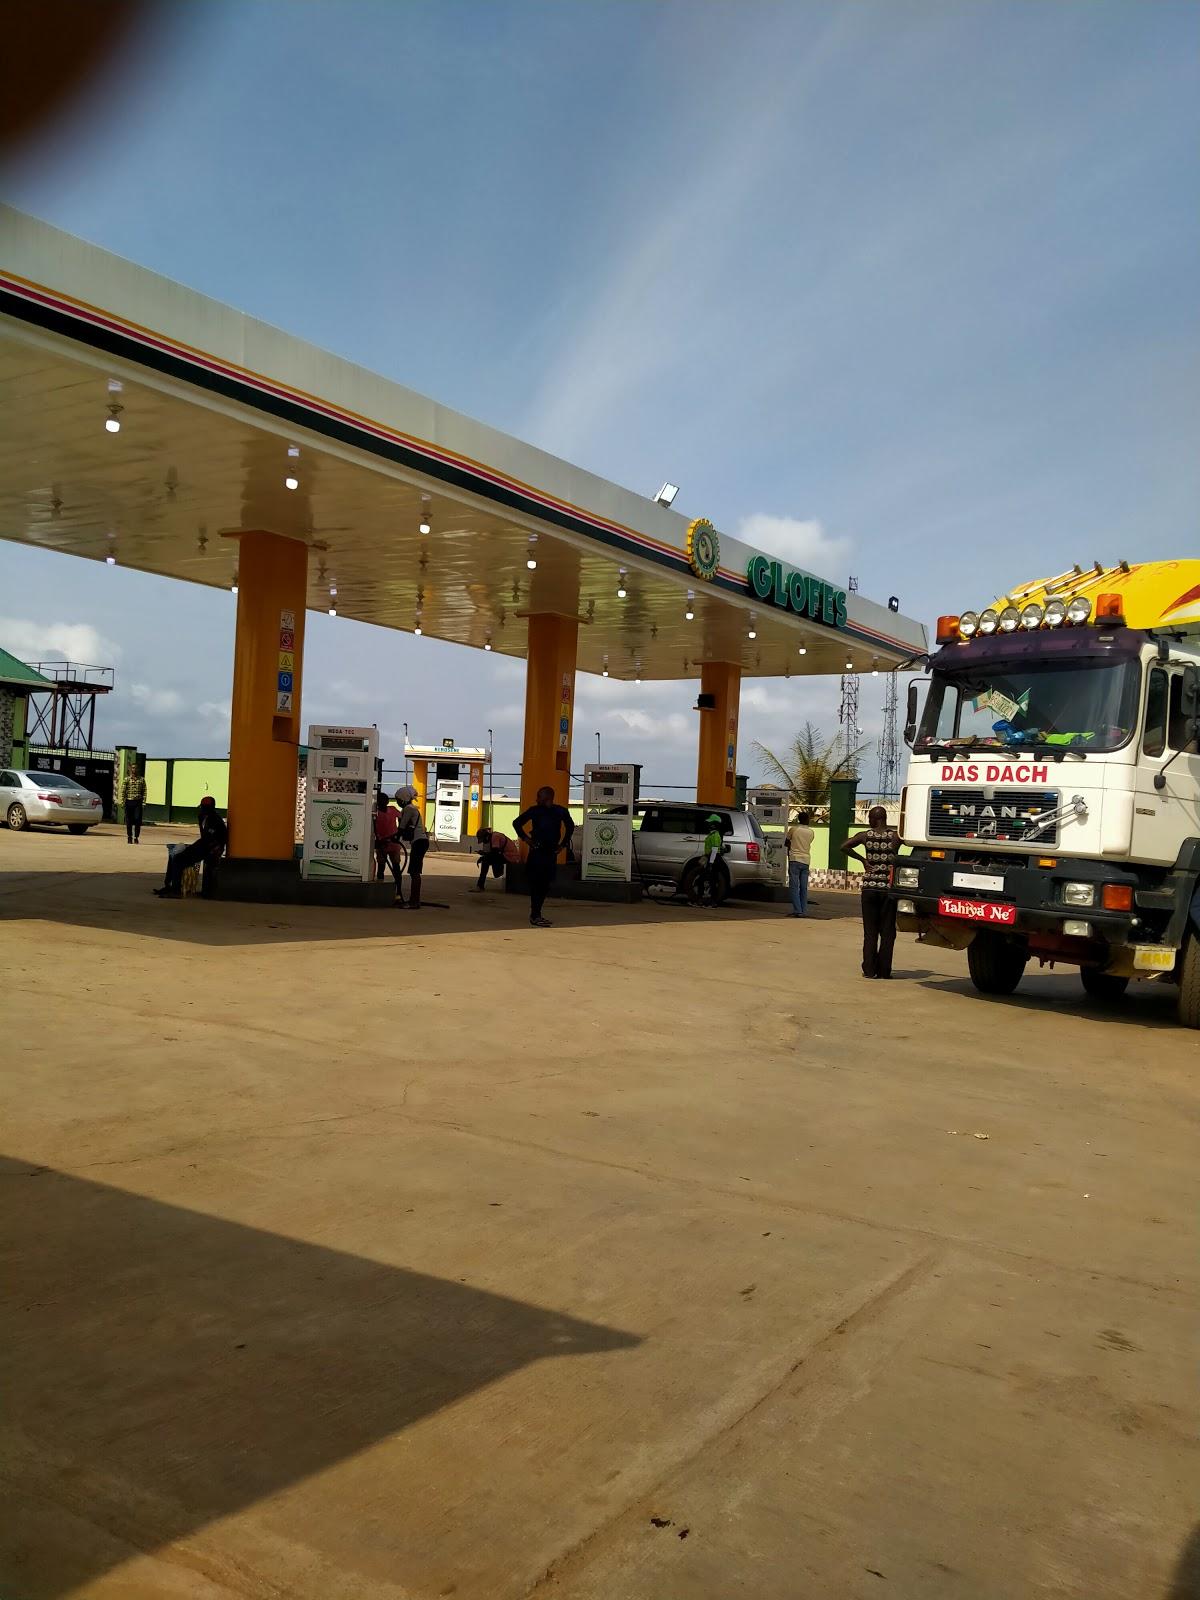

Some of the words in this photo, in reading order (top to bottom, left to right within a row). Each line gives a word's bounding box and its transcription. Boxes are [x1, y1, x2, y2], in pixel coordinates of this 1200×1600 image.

[747, 555, 848, 627] GLOFES
[941, 765, 979, 782] DAS
[986, 765, 1048, 783] DACH
[959, 804, 1017, 818] MAN
[314, 839, 359, 851] Glofes
[590, 847, 624, 856] Glofes
[1140, 952, 1171, 965] MAN
